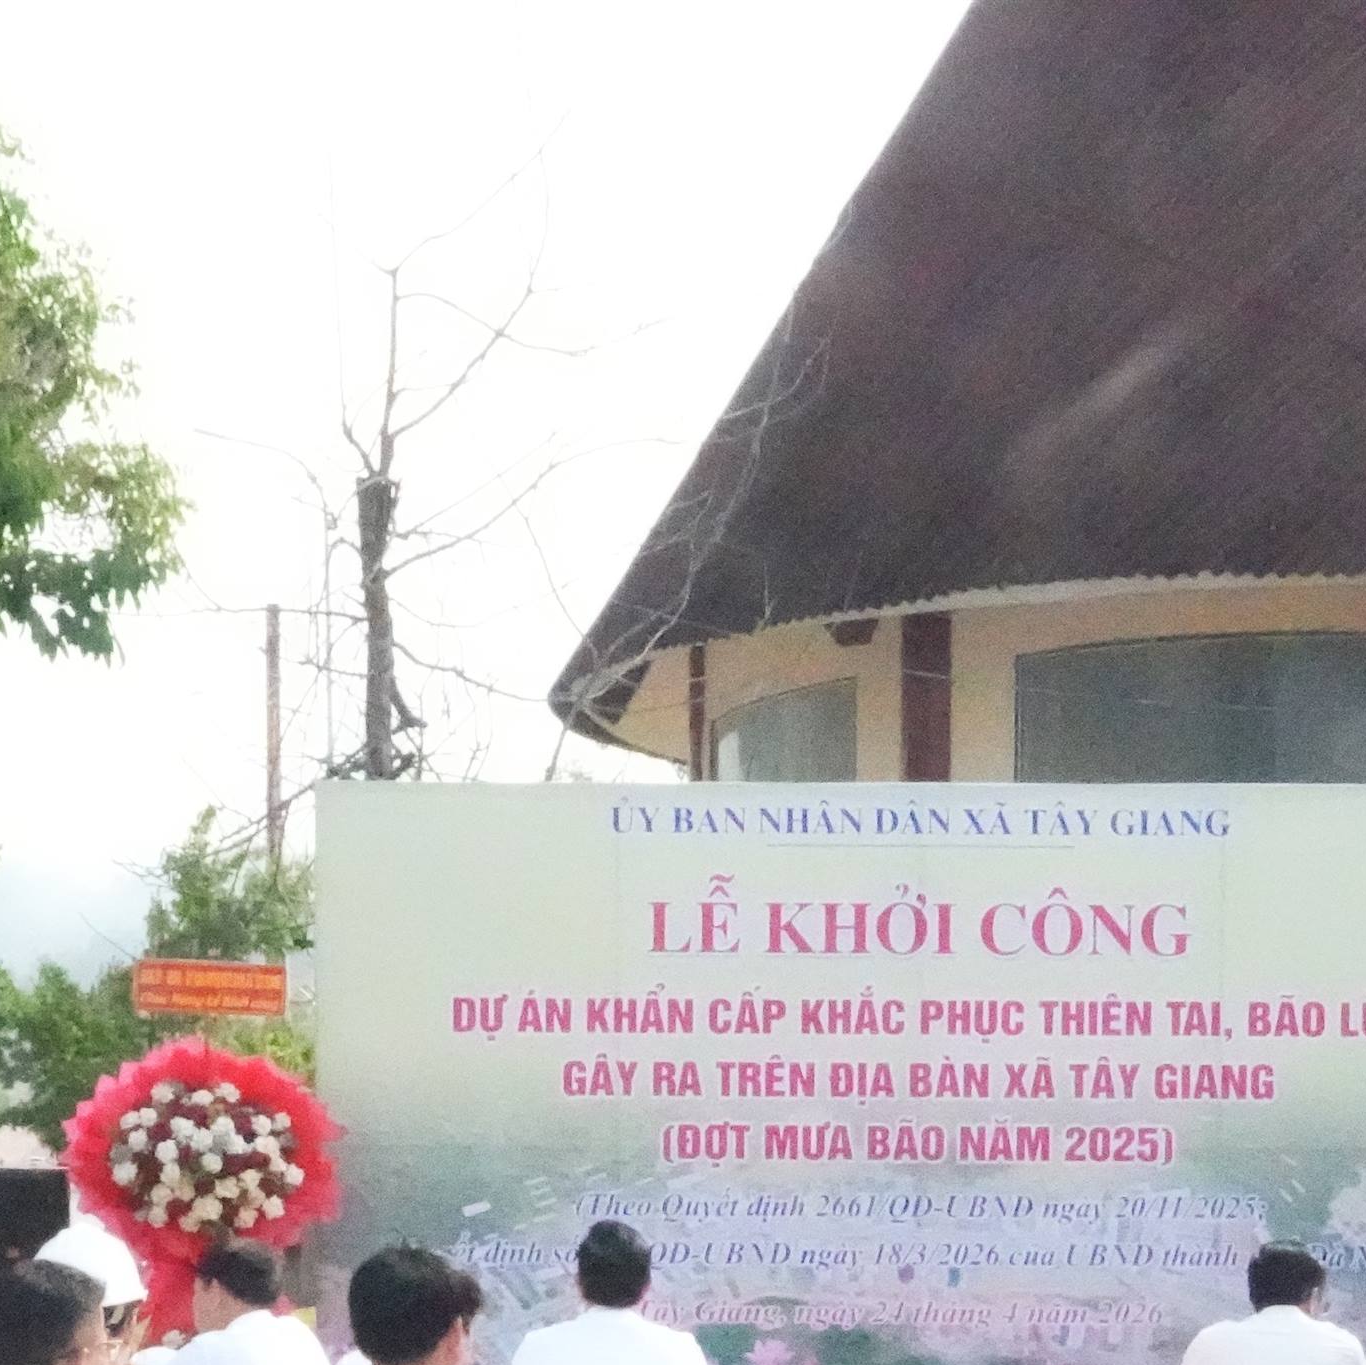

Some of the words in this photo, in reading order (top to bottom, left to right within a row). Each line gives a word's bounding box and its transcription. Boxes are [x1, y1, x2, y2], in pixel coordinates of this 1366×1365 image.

[612, 797, 660, 833] ỦY
[673, 807, 746, 834] BAN
[759, 800, 862, 834] NHÂN
[875, 800, 950, 834] DÂN
[964, 802, 1011, 835] XÃ
[1024, 801, 1098, 835] TÂY
[1110, 808, 1230, 836] GIANG
[648, 873, 740, 952] LỄ
[766, 883, 956, 954] KHỞI
[980, 886, 1192, 956] CÔNG
[453, 993, 509, 1041] DỰ
[517, 989, 571, 1033] ÁN
[586, 983, 694, 1034] KHẨN
[708, 985, 786, 1034] CẤP
[801, 985, 905, 1035] KHẮC
[920, 1000, 1025, 1043] PHỤC
[1038, 993, 1152, 1036] THIÊN
[1166, 1001, 1233, 1041] TAI,
[1248, 995, 1325, 1037] BÃO
[562, 1053, 638, 1096] GÂY
[652, 1061, 702, 1097] RA
[716, 1054, 815, 1097] TRÊN
[829, 1062, 895, 1106] ĐỊA
[908, 1056, 989, 1098] BÀN
[1004, 1056, 1055, 1099] XÃ
[1069, 1056, 1140, 1099] TÂY
[1154, 1064, 1275, 1100] GIANG
[663, 1121, 750, 1167] (ĐỢT
[764, 1121, 853, 1161] MƯA
[867, 1118, 945, 1161] BÃO
[959, 1118, 1050, 1161] NĂM
[1064, 1126, 1174, 1166] 2025)
[575, 1193, 651, 1218] (Theo
[662, 1187, 739, 1222] Quyết
[747, 1194, 805, 1222] định
[485, 1240, 543, 1269] định
[800, 1246, 863, 1270] ngày
[875, 1241, 999, 1266] 18/3/2026
[1066, 1243, 1154, 1267] UBND
[1162, 1243, 1238, 1267] thành
[794, 1302, 862, 1330] ngày
[872, 1302, 904, 1325] 24
[913, 1302, 992, 1328] tháng
[1002, 1302, 1018, 1324] 4
[1027, 1303, 1087, 1324] năm
